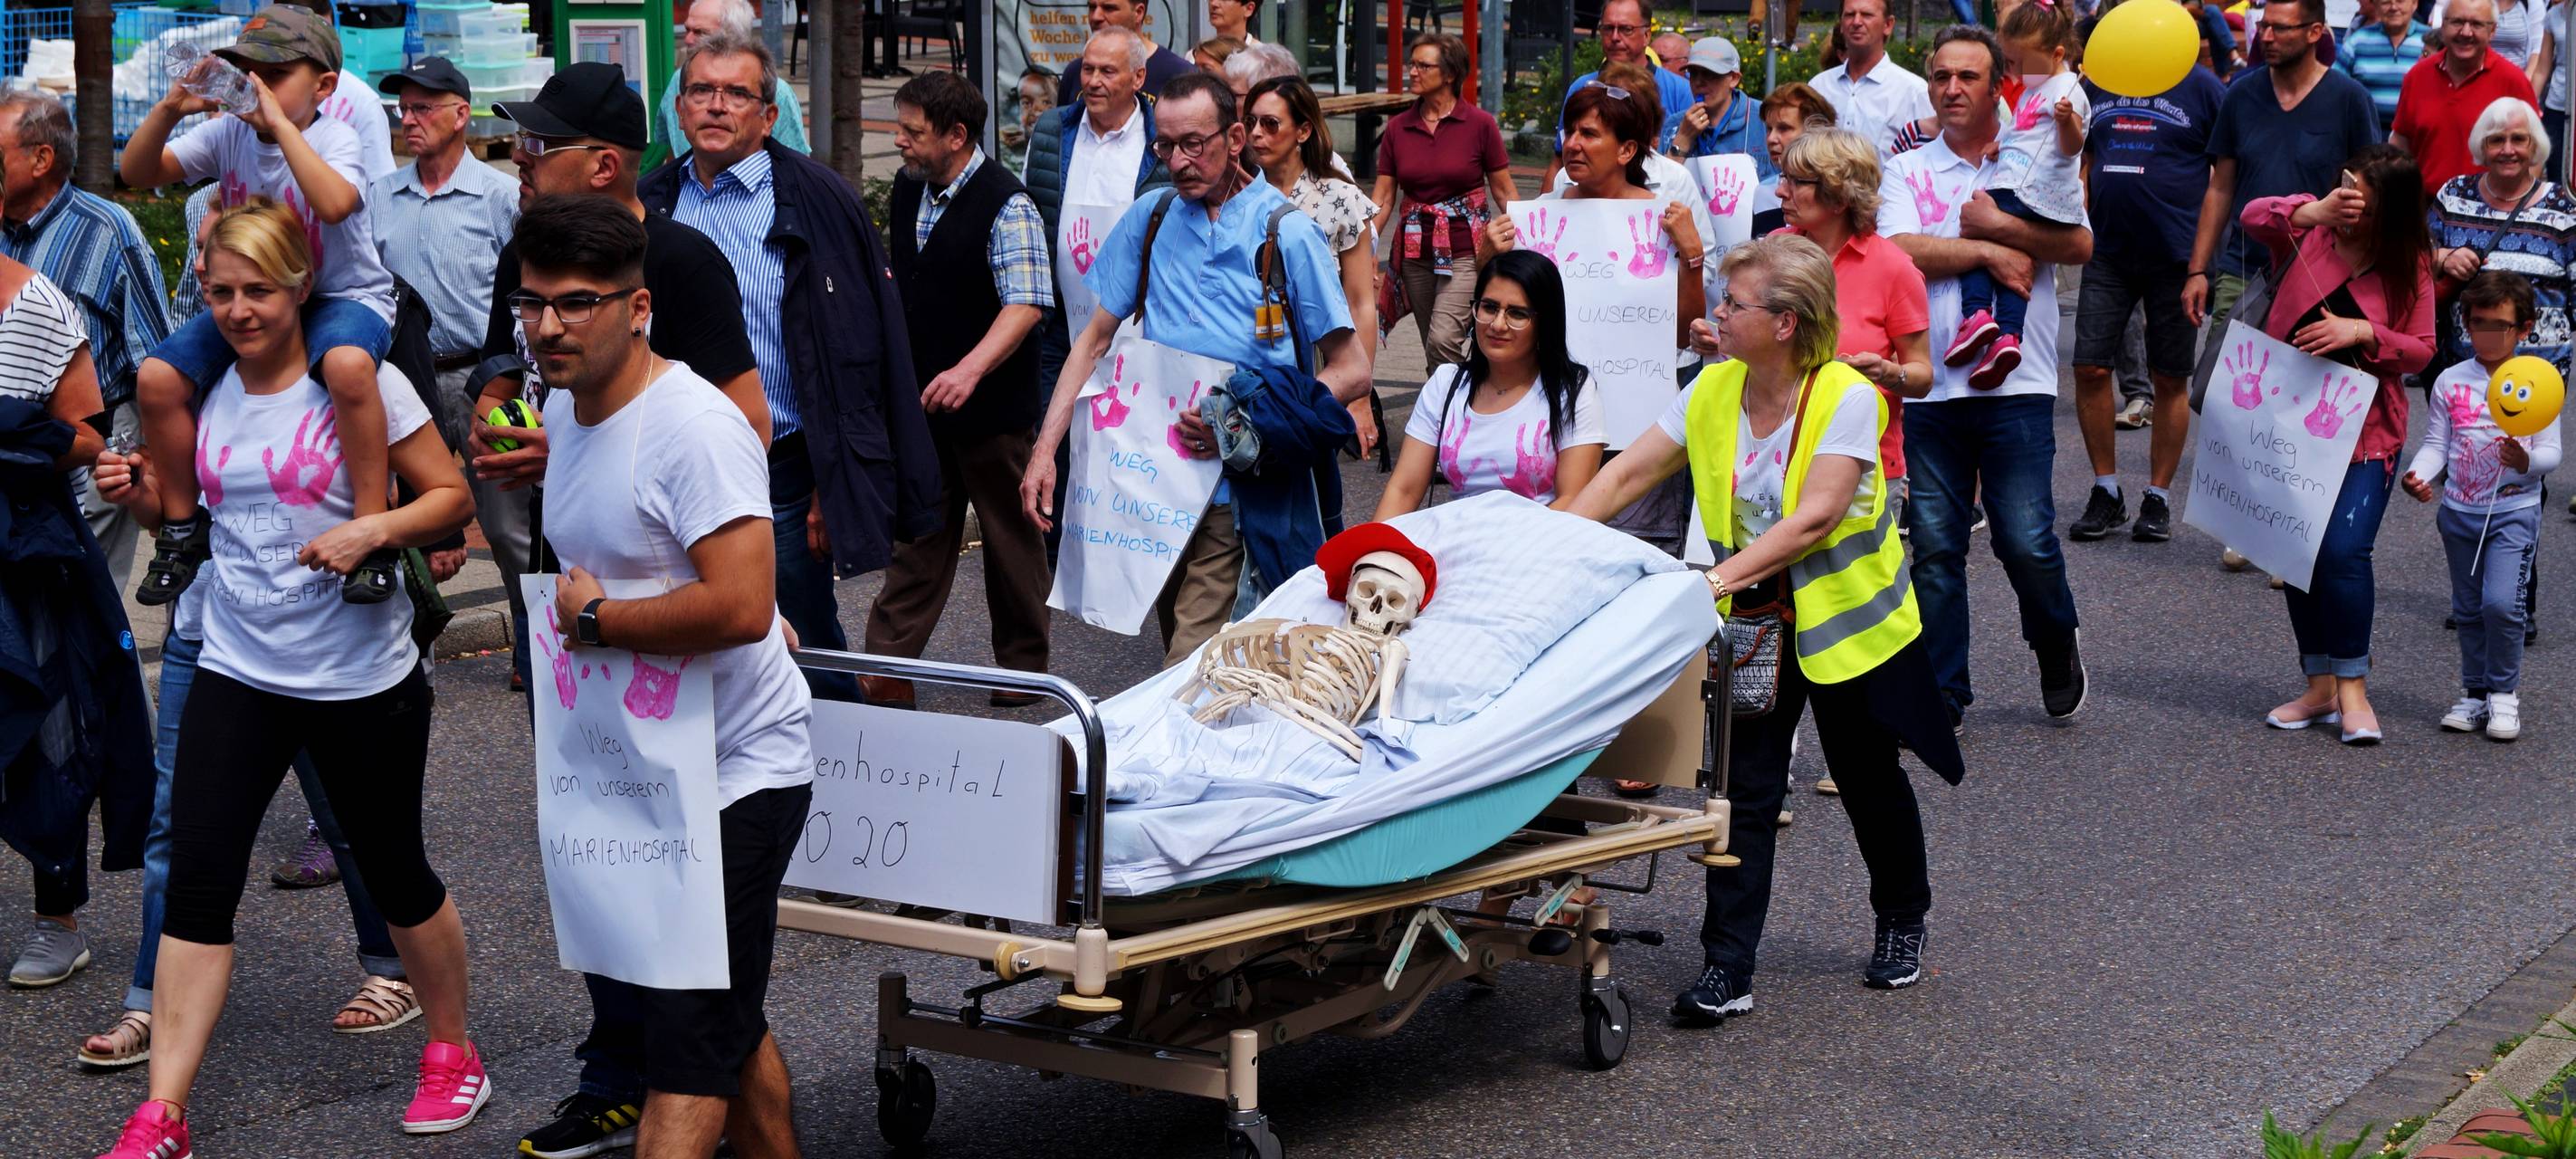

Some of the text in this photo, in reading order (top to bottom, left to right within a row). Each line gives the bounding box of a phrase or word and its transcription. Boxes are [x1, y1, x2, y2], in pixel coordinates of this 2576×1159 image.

[1029, 11, 1078, 25] helfen
[1029, 29, 1080, 43] Woche
[1030, 52, 1050, 62] zu
[1564, 262, 1616, 280] WEG
[1578, 305, 1675, 326] UNSEREM
[1584, 358, 1672, 380] HOSPITAL
[2250, 419, 2297, 469] Weg
[1109, 446, 1159, 484] WEG
[2205, 438, 2325, 496] von unserem
[1111, 493, 1200, 532] UNSERE
[2196, 467, 2313, 543] MARIENHOSPITAL
[255, 574, 346, 607] HOSPITA
[579, 723, 629, 770] Weg
[549, 774, 670, 798] von unserem
[549, 832, 702, 868] MARIENHOSPITAL
